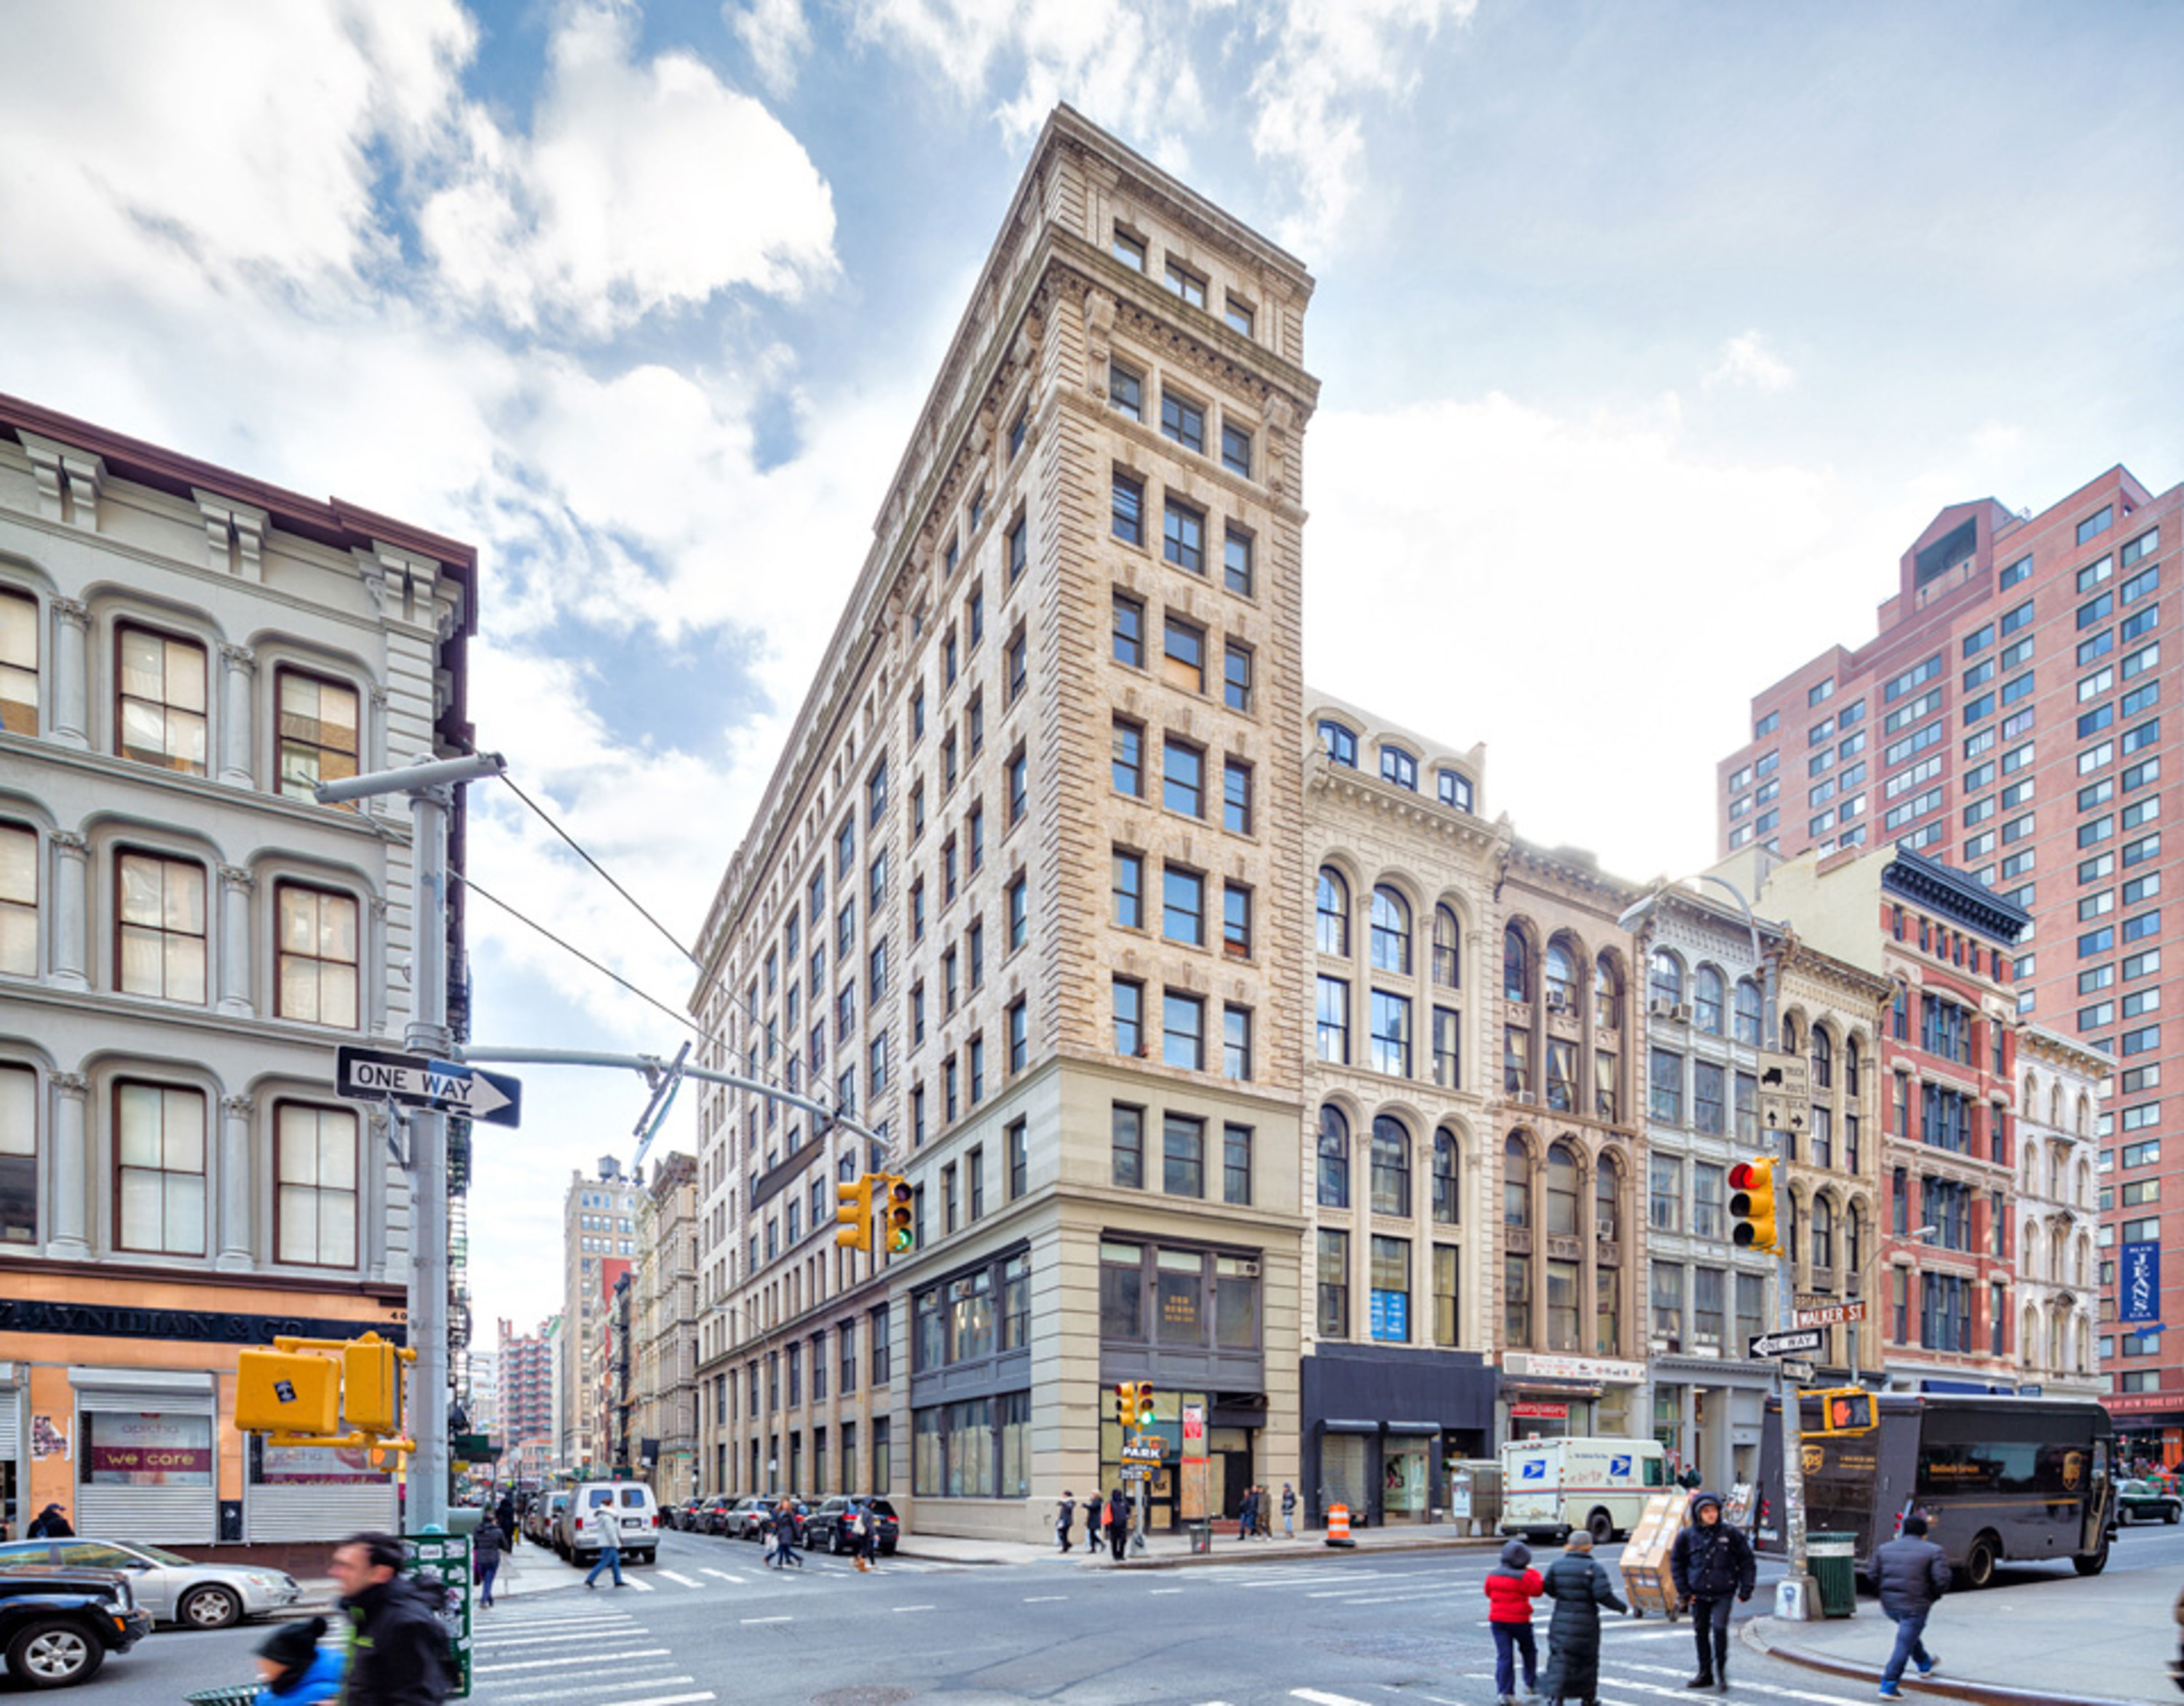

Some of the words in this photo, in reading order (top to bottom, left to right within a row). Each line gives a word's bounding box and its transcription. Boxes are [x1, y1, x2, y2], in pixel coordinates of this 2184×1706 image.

[357, 1064, 408, 1090] ONE
[422, 1074, 472, 1101] WAY
[2131, 1253, 2151, 1312] JEANS
[1800, 1308, 1843, 1325] WALKER
[1848, 1305, 1861, 1320] ST
[1760, 1340, 1780, 1352] ONE
[1788, 1336, 1812, 1348] WAY
[107, 1453, 138, 1465] we
[146, 1453, 195, 1465] care
[1123, 1446, 1160, 1459] PARK
